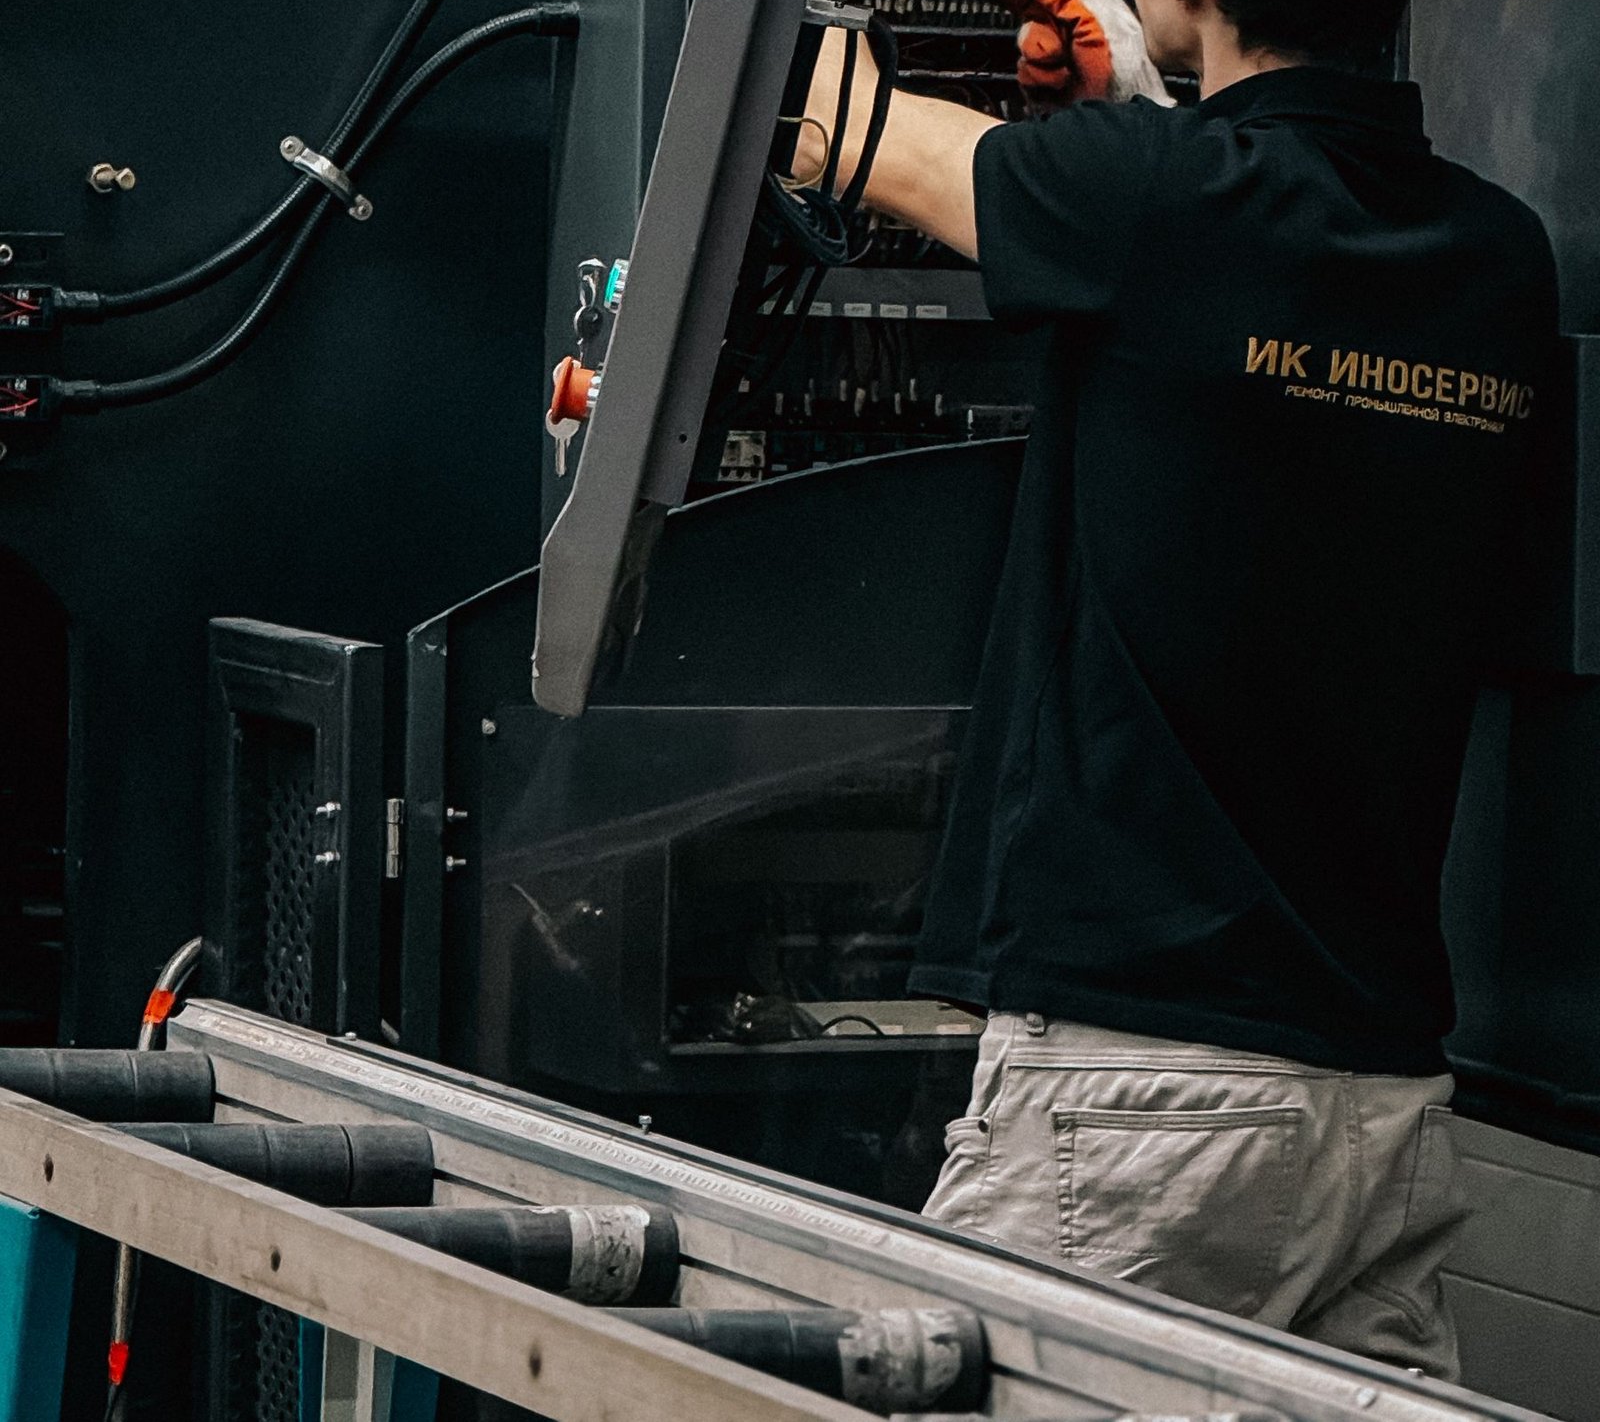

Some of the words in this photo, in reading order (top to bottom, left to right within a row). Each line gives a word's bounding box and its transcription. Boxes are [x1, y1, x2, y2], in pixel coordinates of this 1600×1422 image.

[1245, 336, 1311, 378] ИК
[1328, 349, 1534, 419] ИНОСЕРВИС
[1284, 385, 1340, 403] РЕМОНТ
[1345, 394, 1440, 422] ПРОМЫШЛЕННОЙ
